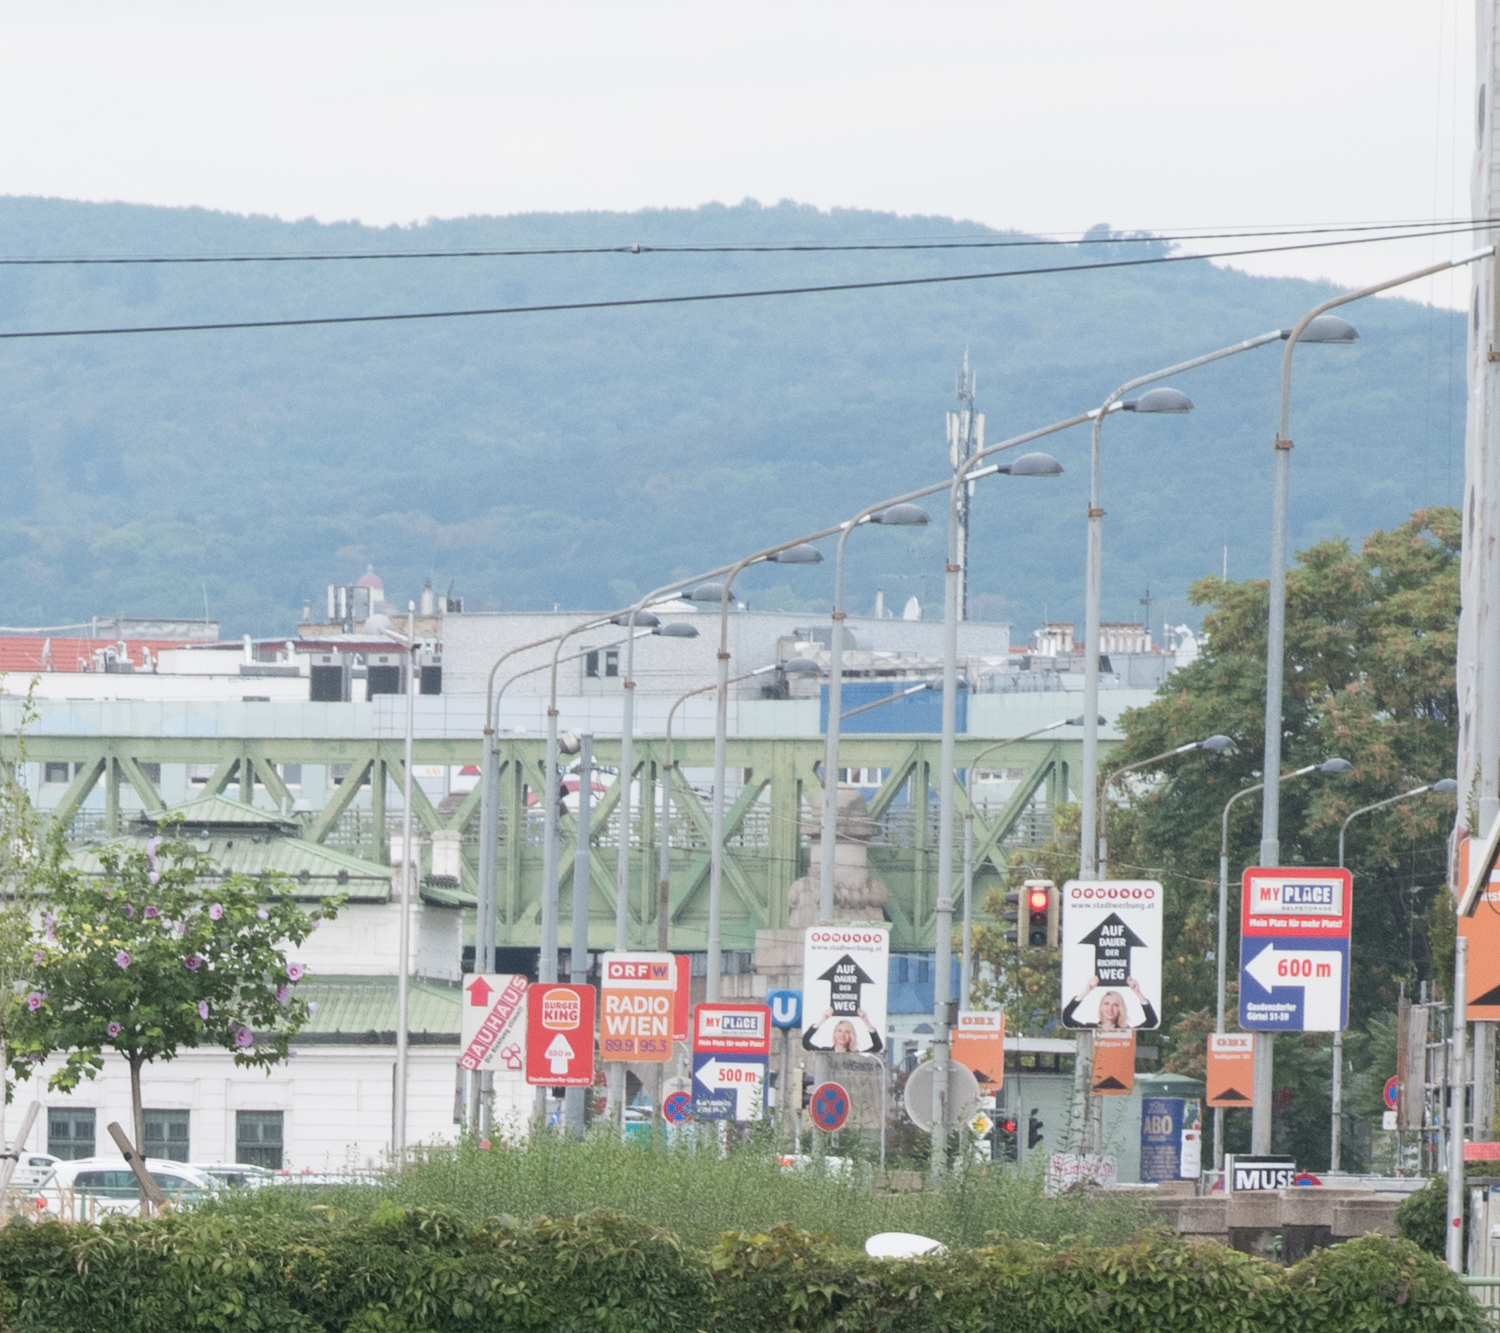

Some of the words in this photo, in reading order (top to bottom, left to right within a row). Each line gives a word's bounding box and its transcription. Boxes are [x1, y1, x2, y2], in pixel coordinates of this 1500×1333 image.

[1260, 887, 1281, 901] MY
[1284, 886, 1331, 903] PLACE
[1101, 925, 1125, 937] AUF
[1099, 938, 1126, 947] DAUER
[610, 964, 649, 977] ORF
[835, 964, 856, 975] AUF
[1099, 969, 1125, 980] WEG
[1277, 958, 1312, 977] 600
[1316, 963, 1331, 978] m
[544, 1001, 579, 1010] BURGER
[605, 995, 670, 1015] RADIO
[772, 997, 797, 1023] U
[834, 1001, 856, 1011] WEG
[461, 975, 528, 1069] BAUHAUS
[544, 1010, 578, 1022] KING
[723, 1016, 757, 1030] PLACE
[605, 1016, 669, 1036] WIEN
[718, 1068, 742, 1082] 500
[745, 1071, 756, 1082] m
[1143, 1116, 1174, 1135] ABO
